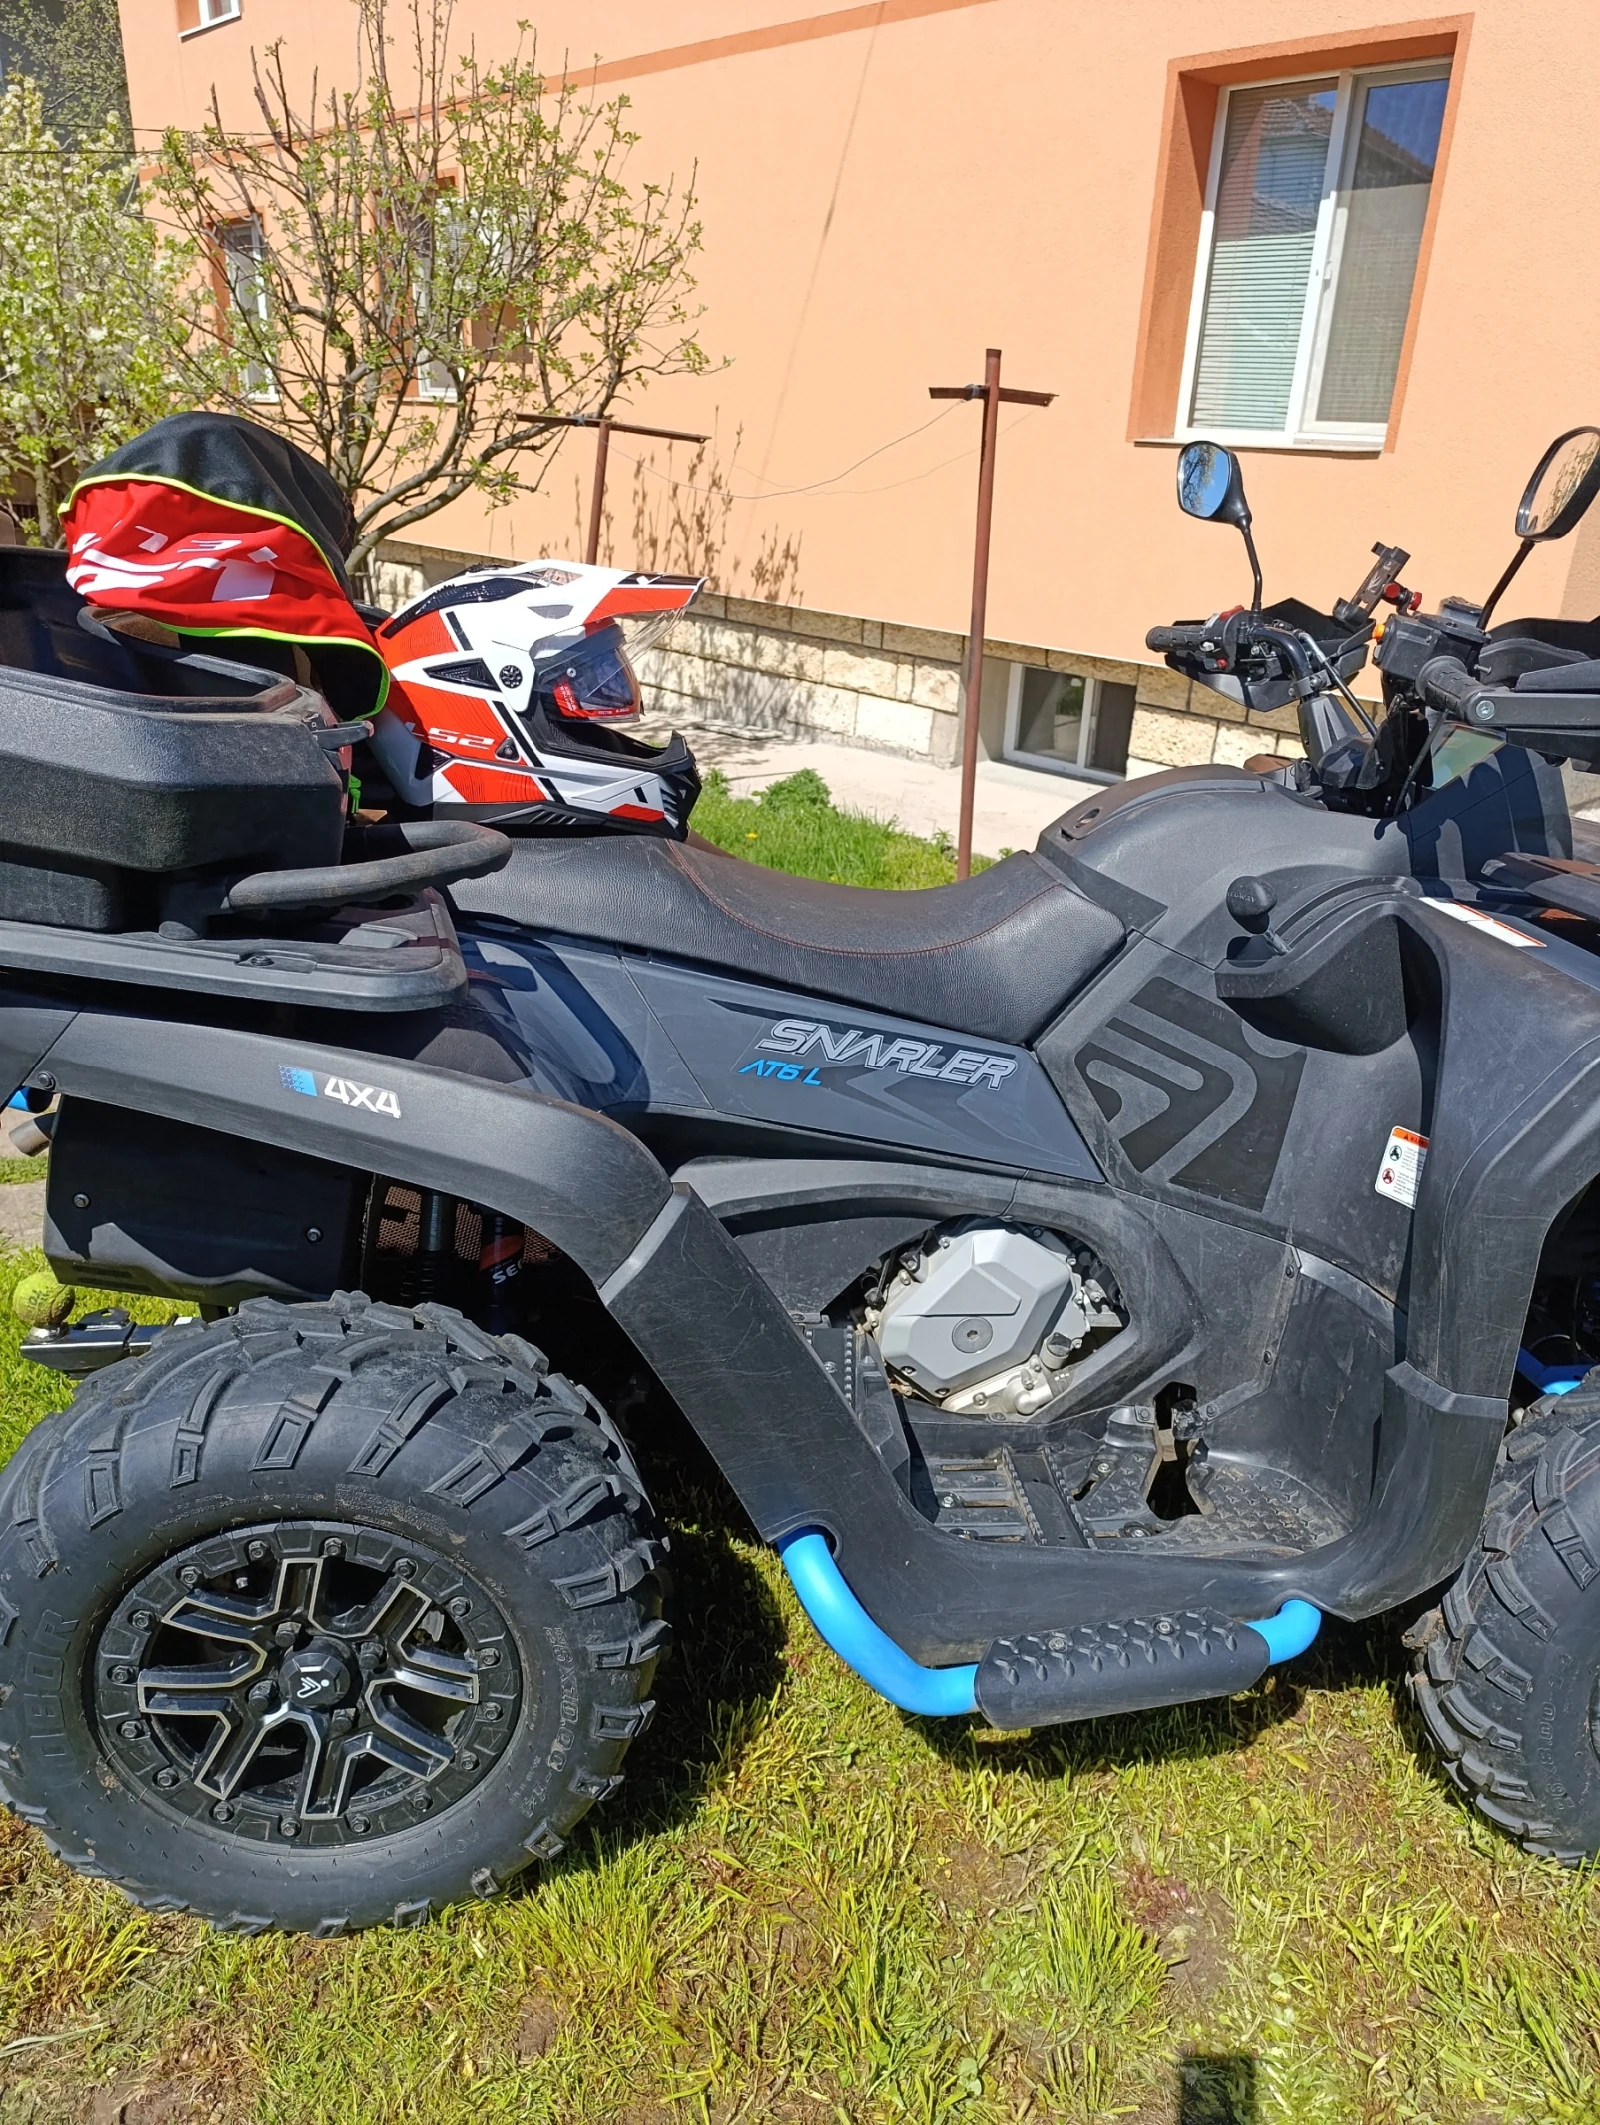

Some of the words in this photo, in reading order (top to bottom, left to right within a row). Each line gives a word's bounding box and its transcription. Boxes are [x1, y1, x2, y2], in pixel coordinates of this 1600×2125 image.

[405, 722, 495, 750] LS2
[738, 1059, 805, 1080] AT6
[802, 1066, 822, 1086] L
[755, 1019, 1018, 1091] SNARLER
[324, 1077, 401, 1119] 4X4
